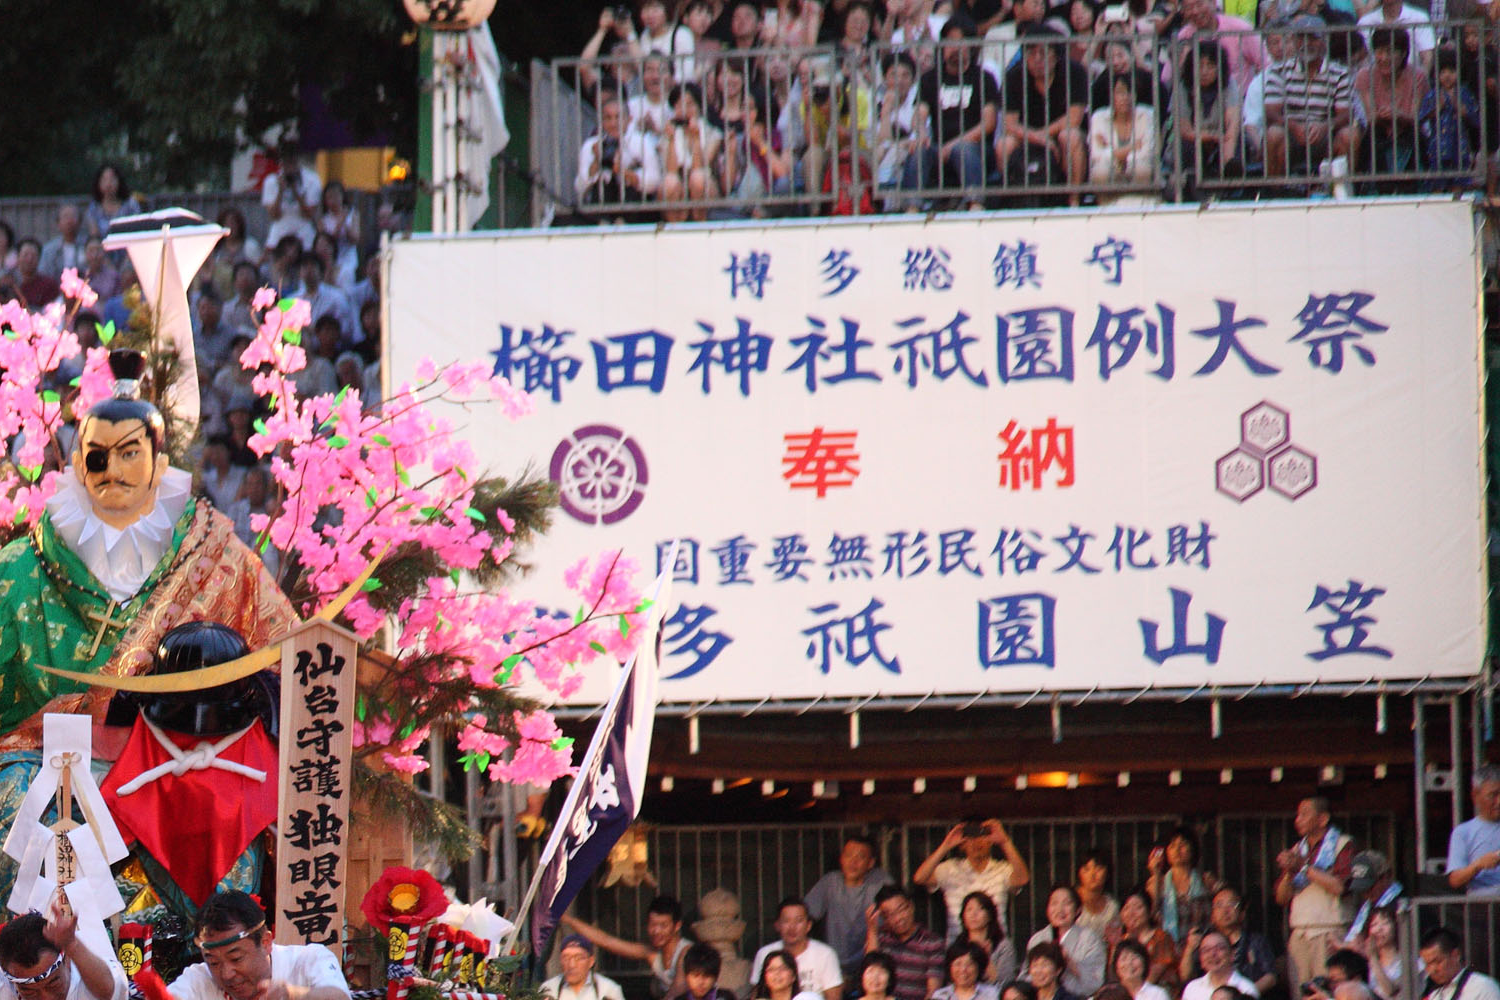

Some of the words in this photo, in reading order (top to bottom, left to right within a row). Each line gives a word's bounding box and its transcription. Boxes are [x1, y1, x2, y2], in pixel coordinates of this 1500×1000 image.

[723, 236, 1134, 300] 博多総鎮守
[488, 291, 1389, 404] 櫛田神社祇園例大祭
[781, 416, 1076, 500] 奉納
[654, 520, 1217, 586] 国重要無形民俗文化財
[502, 580, 1394, 681] 多祇園山笠
[283, 642, 346, 946] 仙台守護独眼竜
